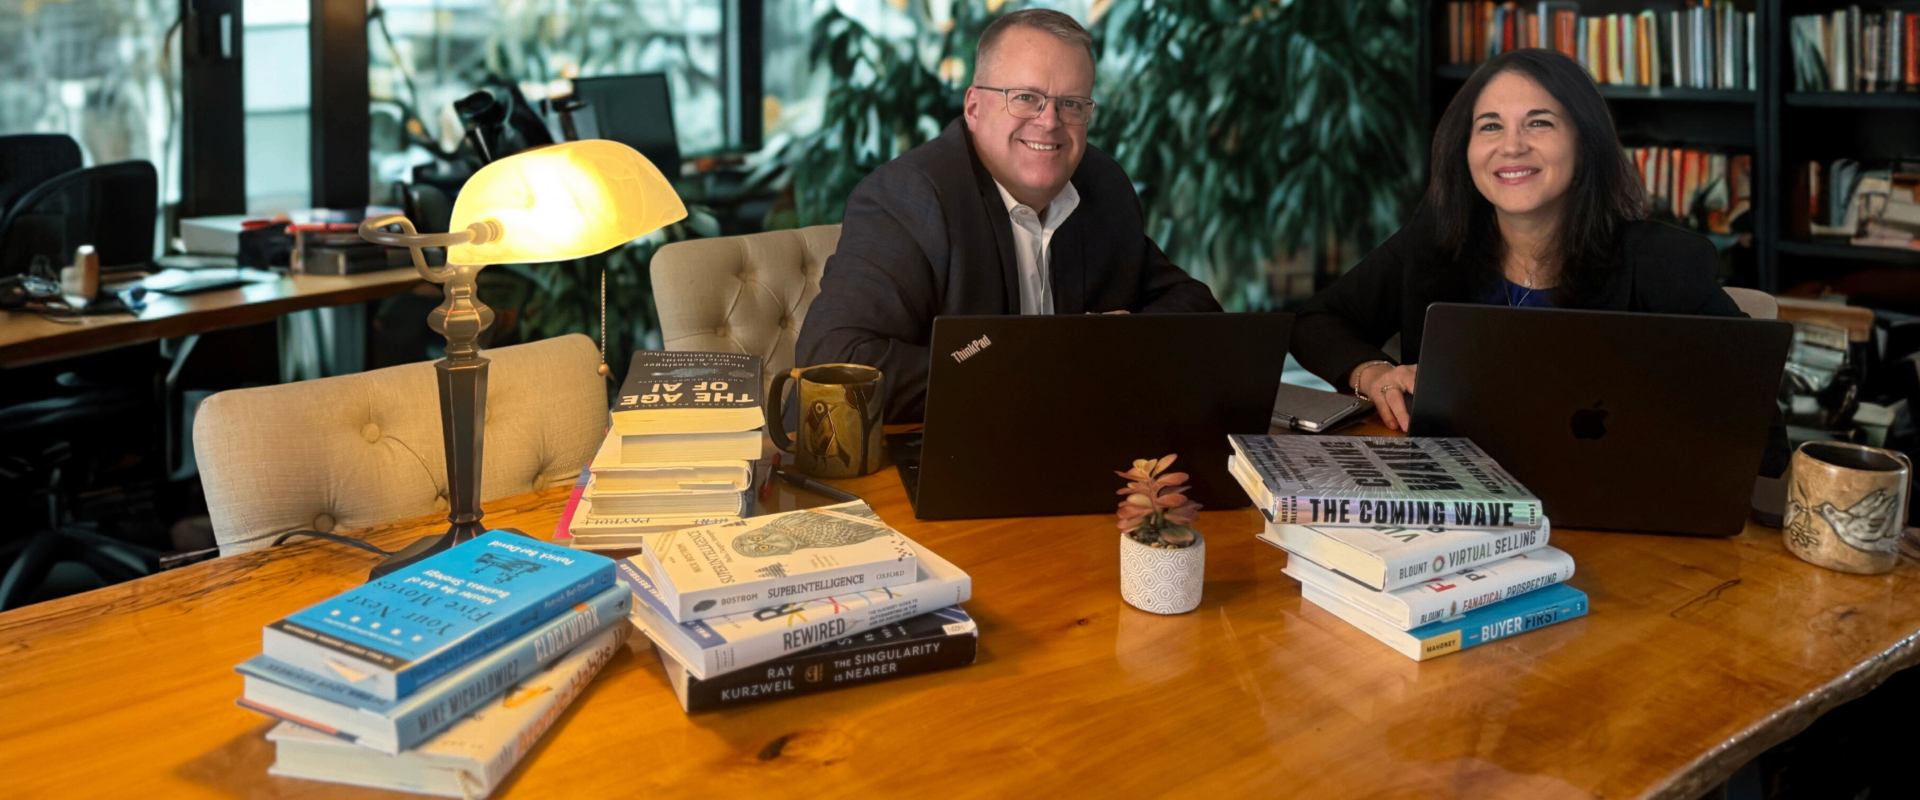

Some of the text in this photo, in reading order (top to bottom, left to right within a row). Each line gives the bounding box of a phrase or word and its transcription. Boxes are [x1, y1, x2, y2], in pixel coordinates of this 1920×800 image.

[951, 334, 991, 363] ThinkPad
[620, 393, 754, 406] THE AGE
[652, 382, 729, 393] OF AI
[1363, 440, 1464, 490] WAVE
[1309, 499, 1514, 527] THE COMING WAVE
[487, 540, 575, 566] Patrick Bet-David
[1399, 561, 1428, 580] BLOUNT
[1449, 543, 1492, 568] VIRTUAL
[1495, 530, 1536, 555] SELLING
[420, 580, 441, 589] Art
[422, 569, 511, 598] Business Strategy
[440, 585, 458, 594] the
[721, 570, 905, 606] BOSTROM SUPERINTELLIGENCE OXFORD
[346, 595, 400, 618] Next
[373, 580, 494, 622] Five Moves
[459, 590, 496, 605] Master
[1420, 608, 1444, 624] BLOUNT
[1462, 590, 1503, 611] FANATICAL
[1506, 572, 1557, 595] PROSPECTING
[401, 611, 455, 636] Your
[783, 617, 846, 651] REWIRED
[1426, 639, 1456, 653] MAHONEY
[1481, 616, 1522, 642] BUYER
[1525, 605, 1559, 629] FIRST
[570, 644, 612, 691] Habits
[834, 642, 941, 668] THE SINGULARITY
[417, 702, 446, 734] MIKE
[449, 658, 519, 716] MICHALOWICZ
[534, 605, 600, 662] CLOCKWORK
[767, 665, 794, 679] RAY
[834, 663, 897, 682] IS NEARER
[721, 679, 795, 701] KURZWEIL
